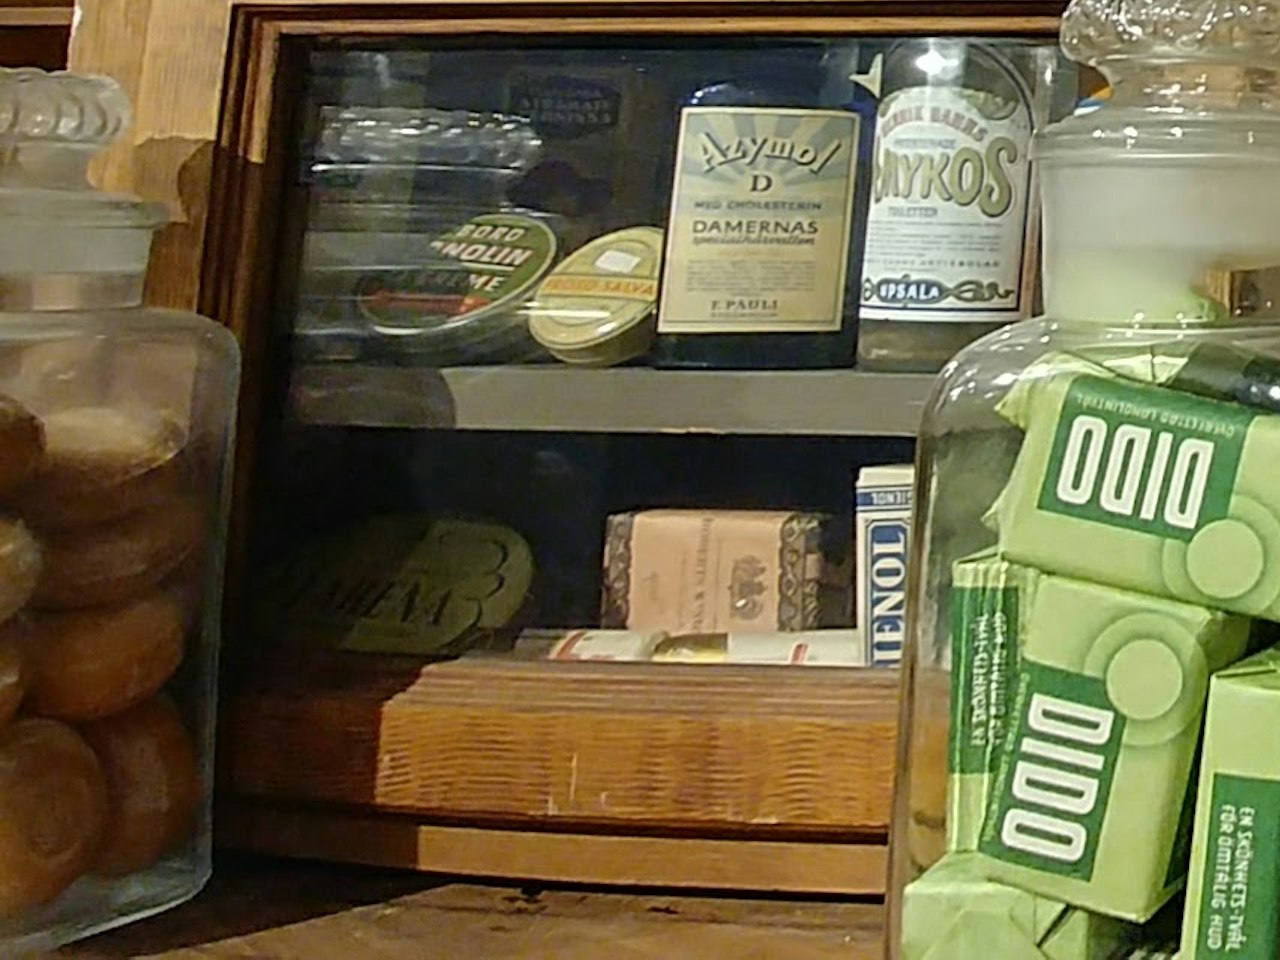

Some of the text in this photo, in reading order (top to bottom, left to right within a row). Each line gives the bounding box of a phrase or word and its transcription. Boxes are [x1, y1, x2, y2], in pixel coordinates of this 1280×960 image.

[699, 132, 842, 176] Azymol
[750, 173, 773, 192] D
[873, 136, 1019, 219] MYKOS
[455, 224, 526, 242] BORO
[692, 219, 819, 235] DAMERNAS
[726, 299, 778, 311] PAULI
[1057, 414, 1215, 529] DIDO
[872, 530, 906, 668] IENOL
[1001, 692, 1116, 864] DIDO
[1239, 806, 1255, 827] EN
[1206, 804, 1238, 951] FÖR ÖMTÅLIG HUD
